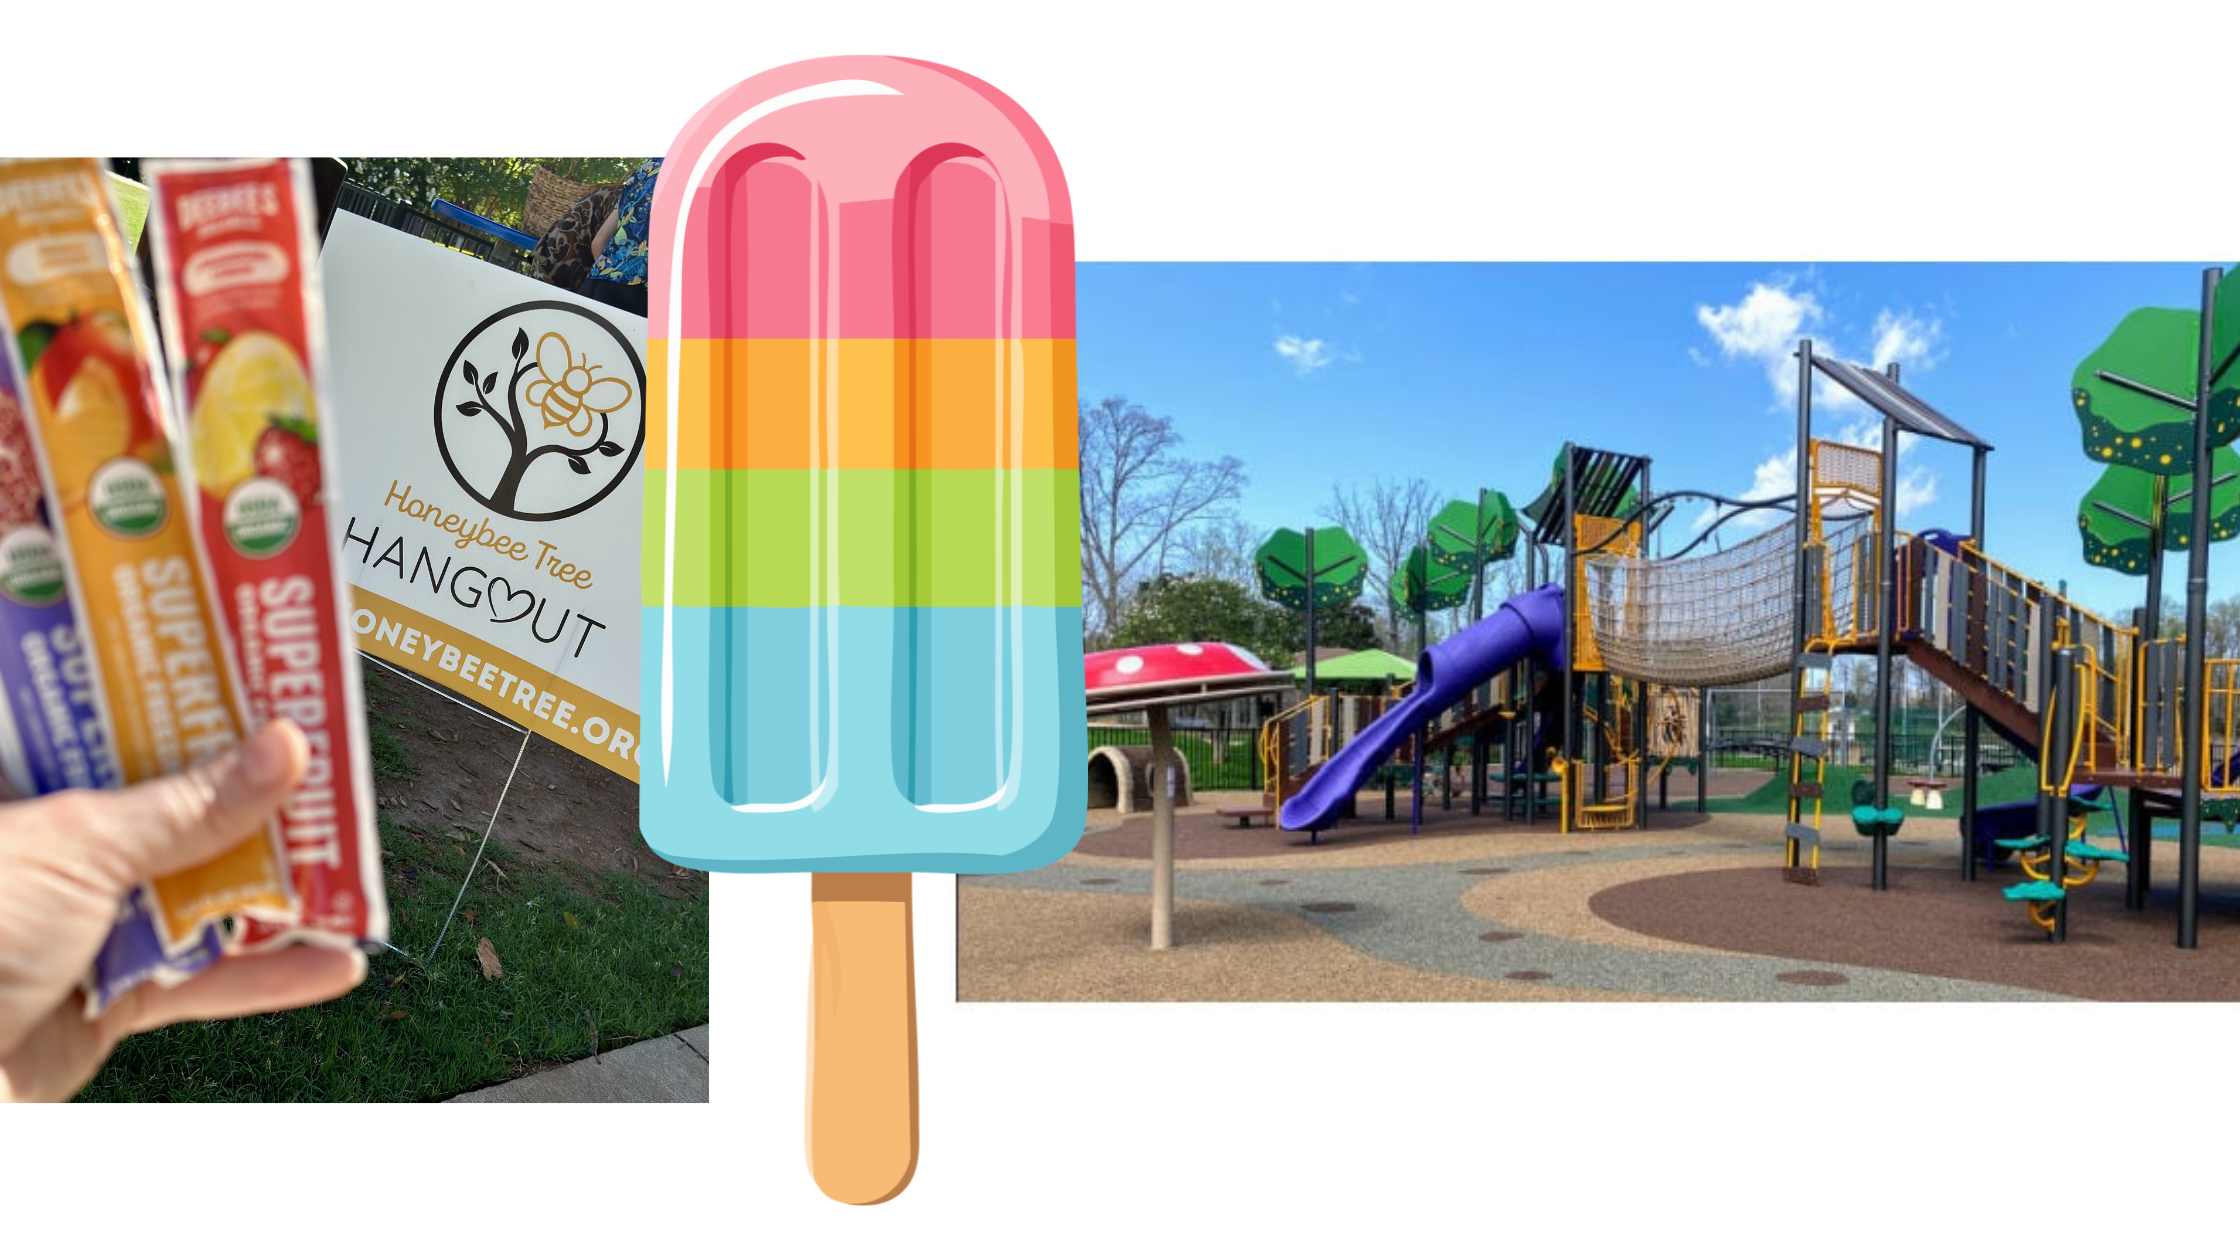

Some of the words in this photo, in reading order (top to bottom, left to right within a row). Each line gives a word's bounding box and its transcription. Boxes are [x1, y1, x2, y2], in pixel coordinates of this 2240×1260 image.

[384, 480, 528, 561] Honeybee
[534, 540, 593, 589] Tree
[345, 601, 640, 767] ONEYBEETREE.OR
